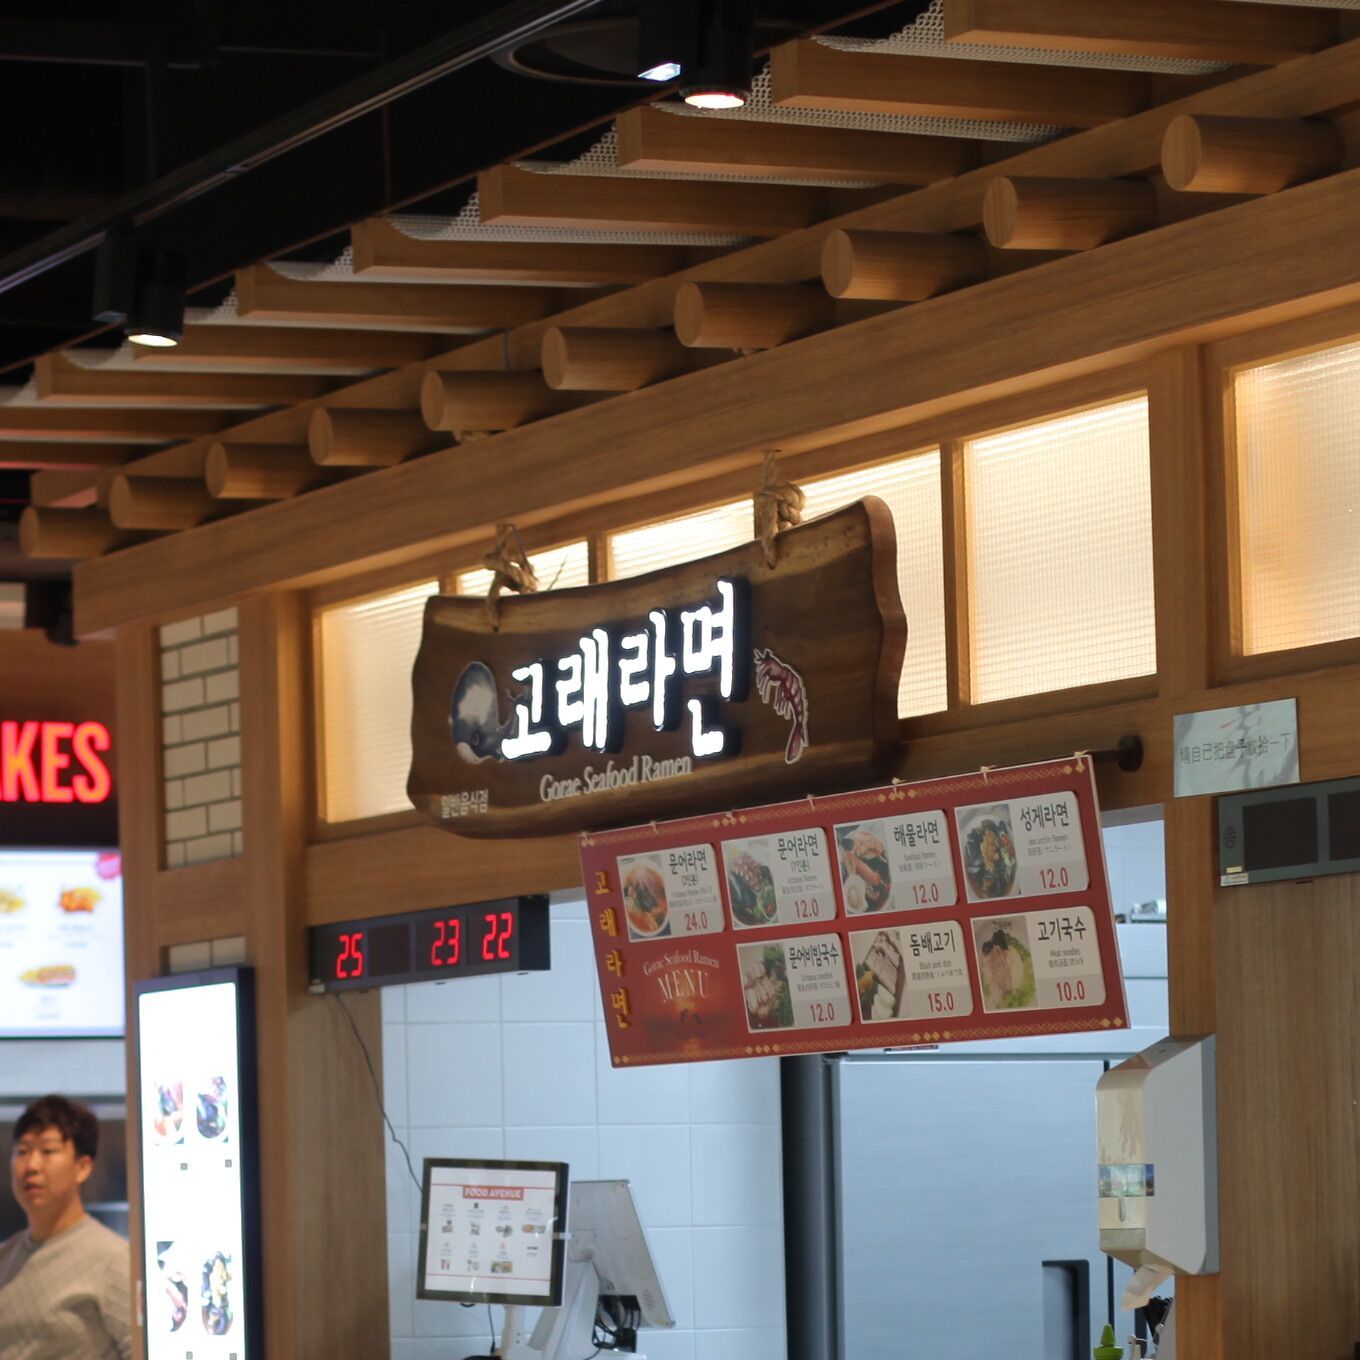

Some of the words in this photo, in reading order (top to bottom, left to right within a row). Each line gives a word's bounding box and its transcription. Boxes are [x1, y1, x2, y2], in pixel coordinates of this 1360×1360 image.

[501, 577, 737, 761] 고래라면
[540, 774, 582, 804] Gorae
[583, 759, 639, 795] Seafood
[641, 754, 694, 782] Ramen
[1020, 802, 1070, 832] 성게라면
[778, 833, 820, 861] 문어라면
[893, 819, 940, 848] 해물라면
[668, 848, 708, 875] 문어라면
[1040, 866, 1069, 889] 12.0
[912, 882, 939, 904] 12.0
[684, 911, 708, 931] 24.0
[794, 898, 820, 919] 12.0
[1038, 915, 1087, 943] 고기국수
[335, 932, 364, 978] 25
[431, 917, 462, 967] 23
[483, 911, 513, 960] 22
[595, 871, 628, 1029] 고래라면
[788, 943, 840, 970] 문어비빔국수
[910, 929, 956, 958] 돔배고기
[657, 969, 708, 1003] MENU
[1056, 980, 1085, 1002] 10.0
[810, 1002, 836, 1023] 12.0
[927, 991, 955, 1013] 15.0
